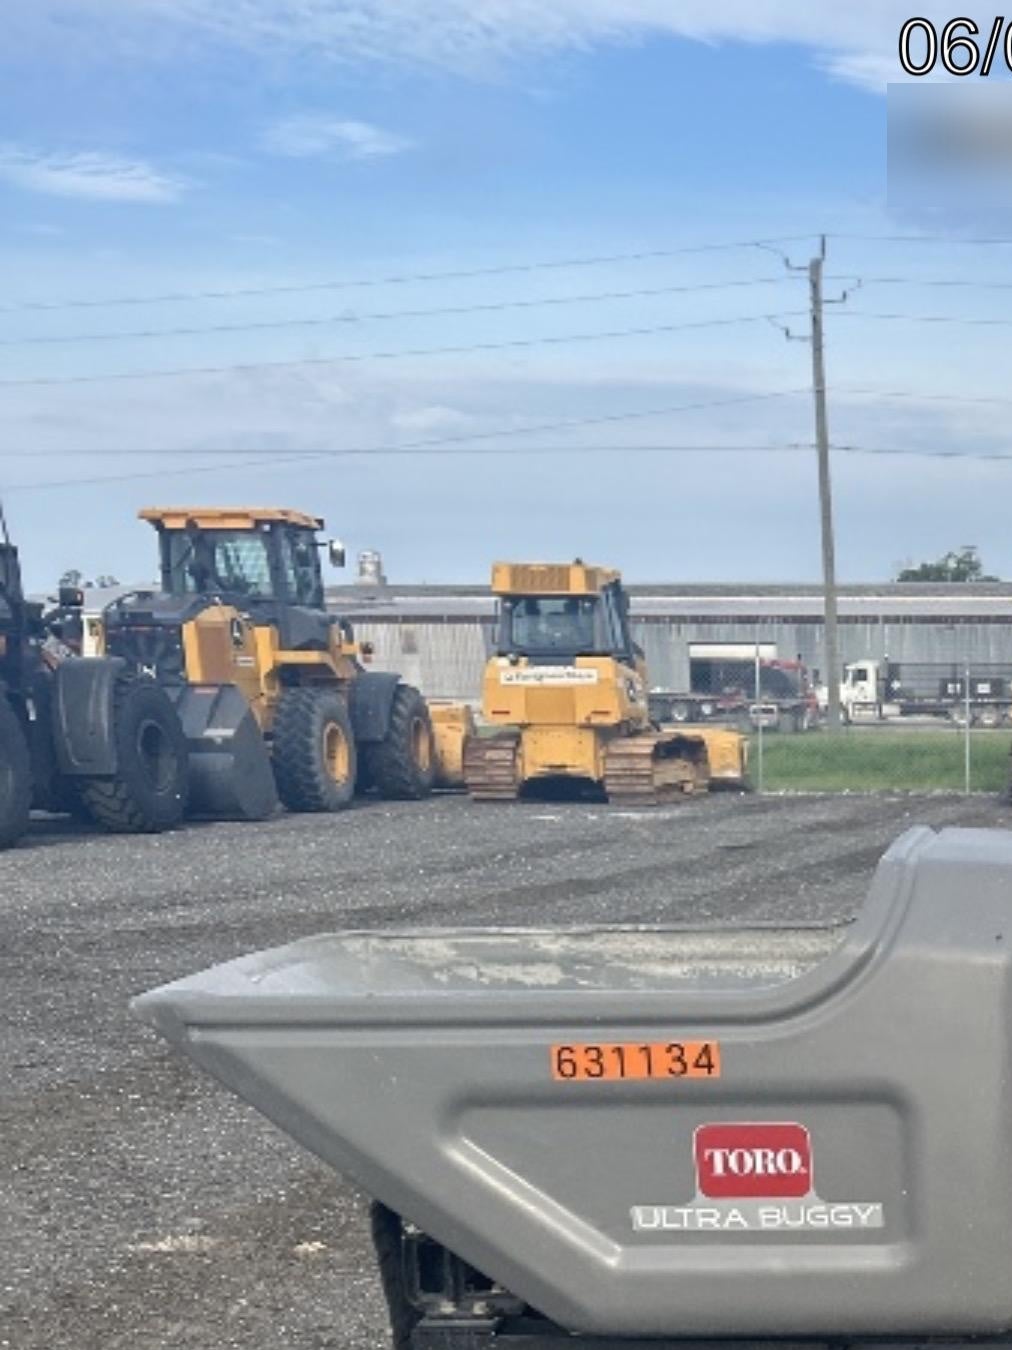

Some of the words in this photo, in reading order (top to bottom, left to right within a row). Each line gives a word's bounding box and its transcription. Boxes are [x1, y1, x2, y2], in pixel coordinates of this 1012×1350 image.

[556, 1043, 715, 1079] 631134
[704, 1148, 804, 1176] TORO
[636, 1208, 748, 1229] ULTRA
[758, 1205, 881, 1227] BUGGY
